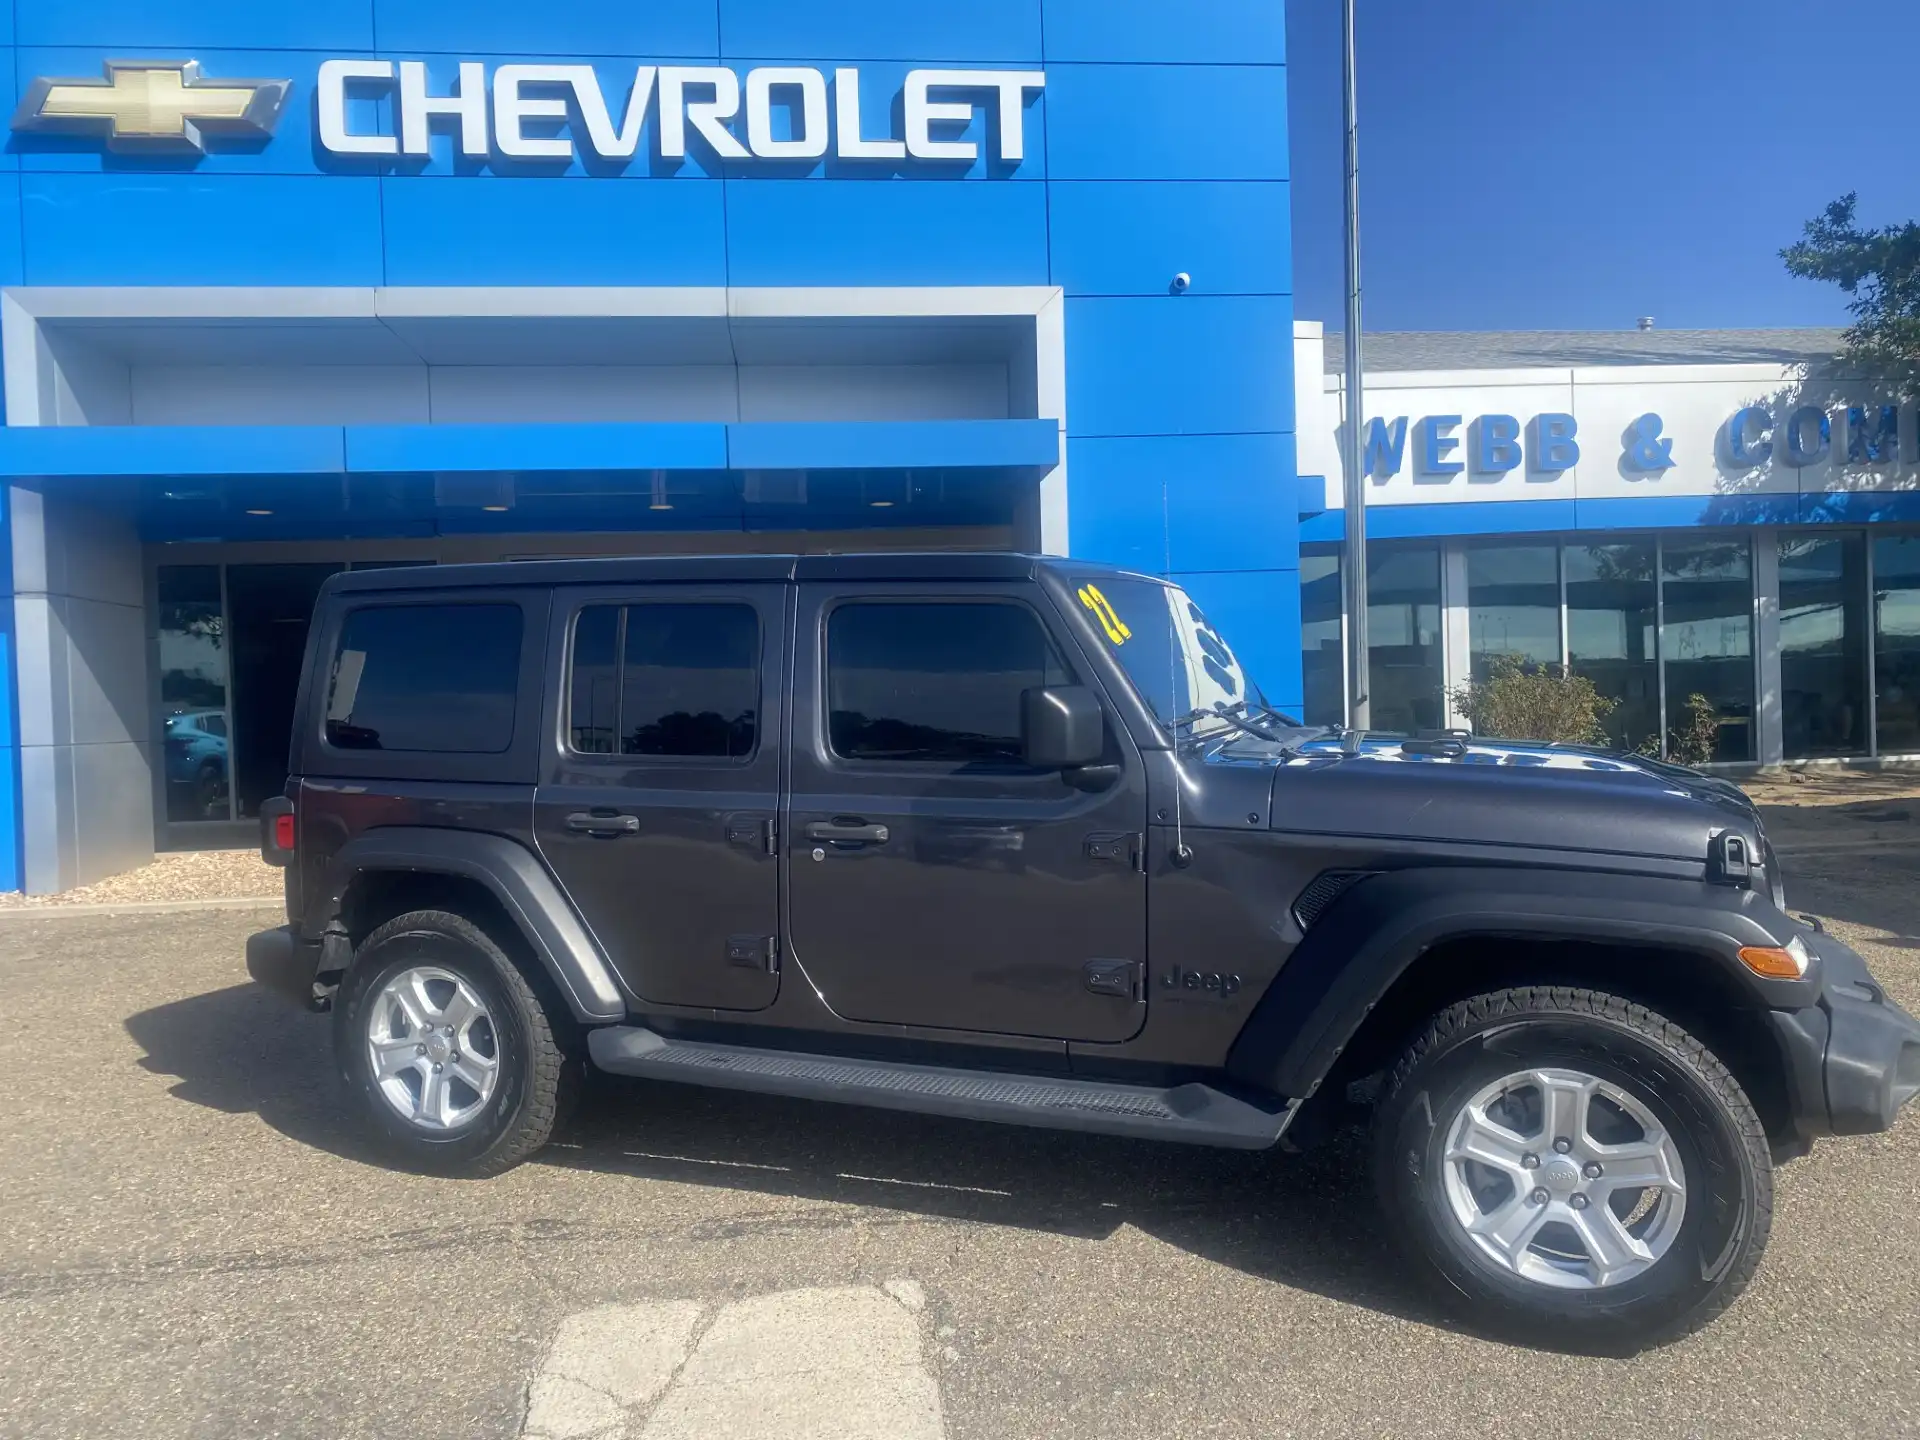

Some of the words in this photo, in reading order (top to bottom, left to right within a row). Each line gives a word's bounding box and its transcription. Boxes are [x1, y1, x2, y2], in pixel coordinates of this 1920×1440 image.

[318, 60, 1045, 161] CHEVROLET
[1350, 412, 1580, 475] WEBB
[1624, 412, 1676, 472] &
[1724, 405, 1920, 468] COM
[1160, 963, 1241, 998] Jeep
